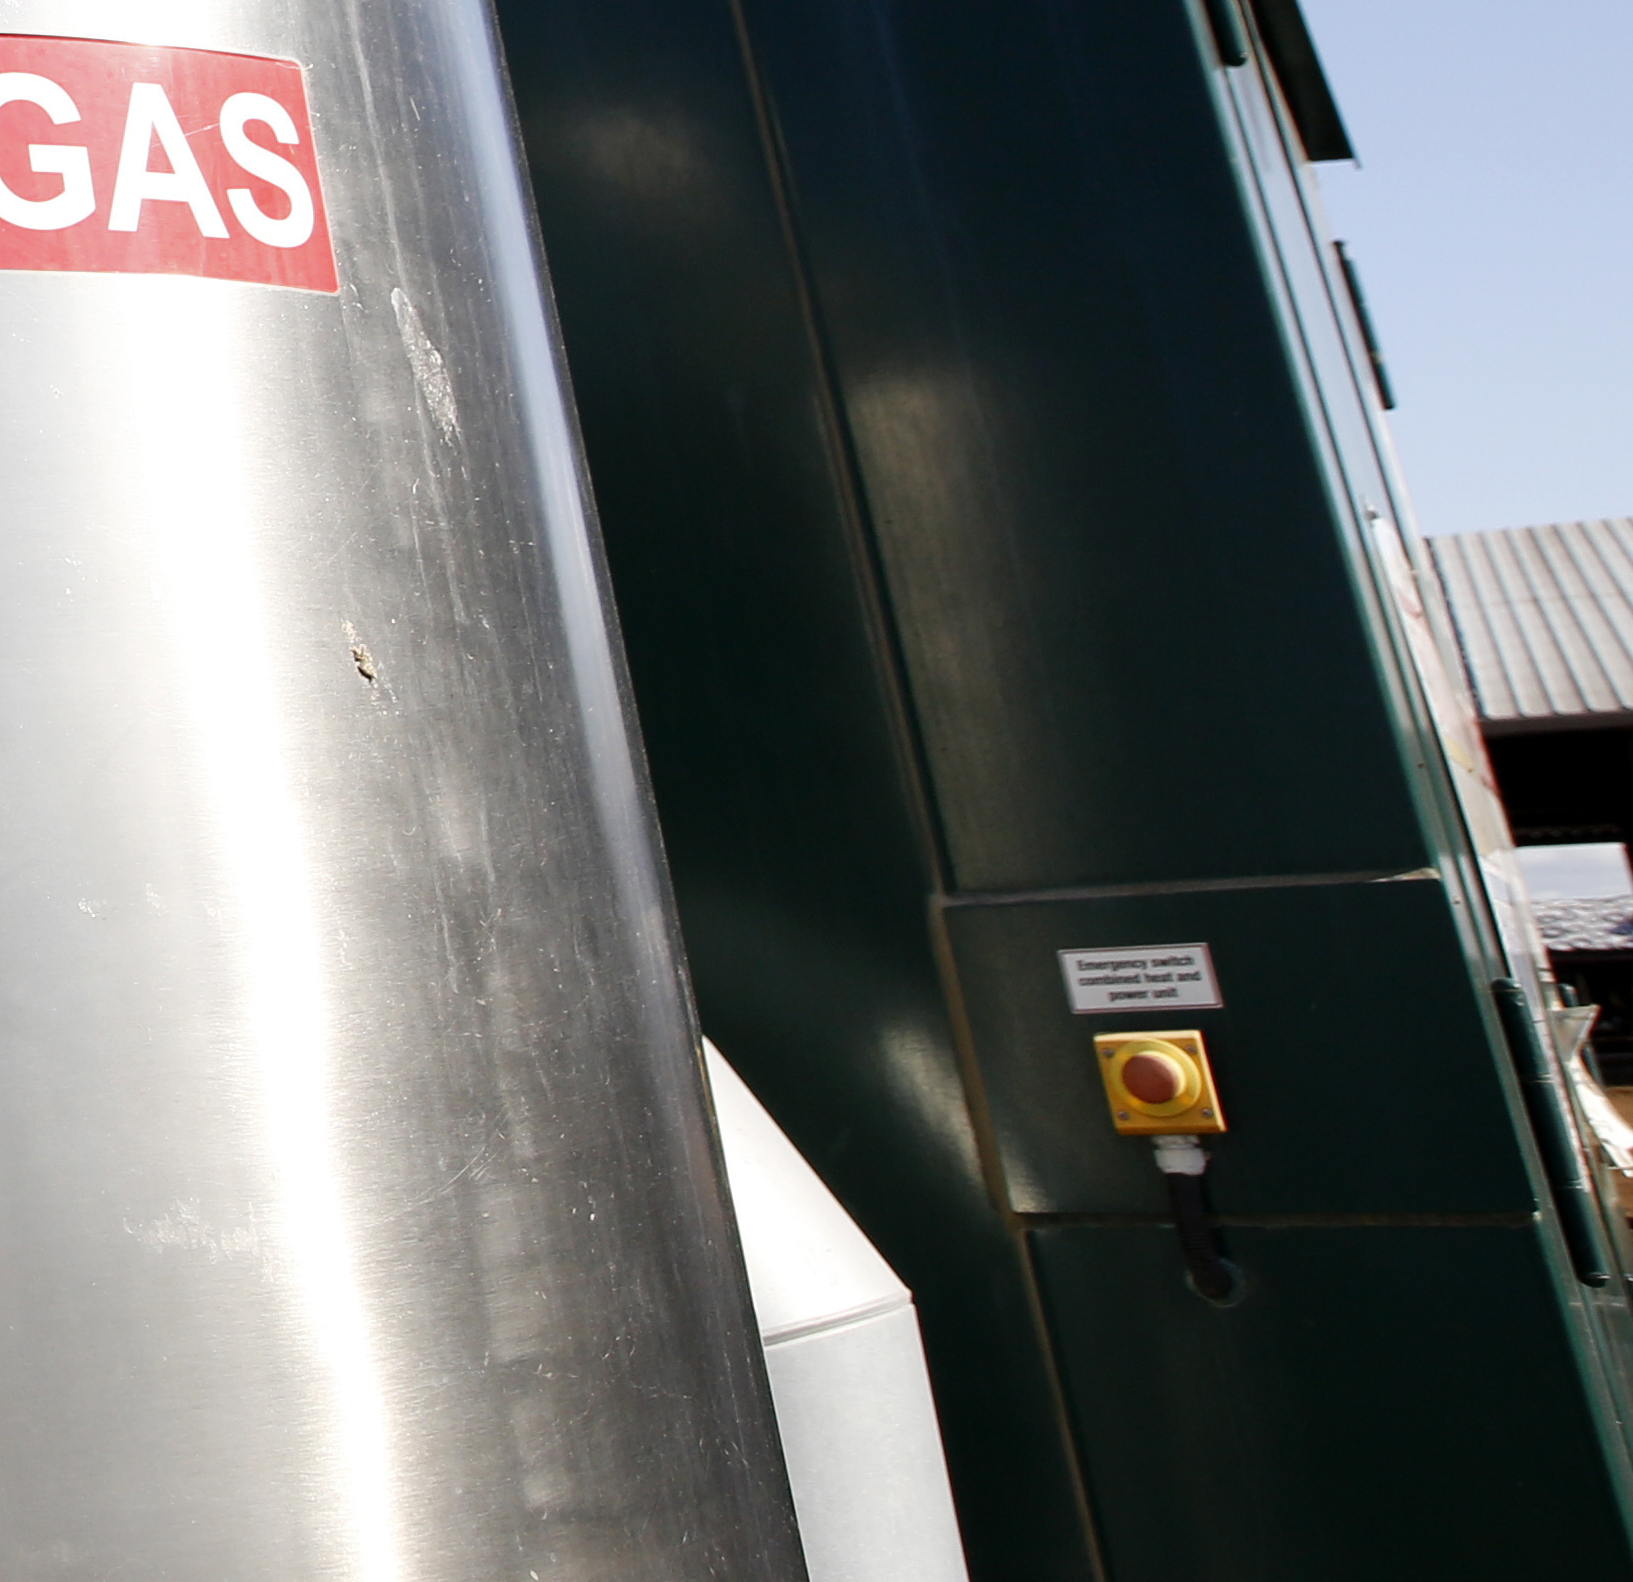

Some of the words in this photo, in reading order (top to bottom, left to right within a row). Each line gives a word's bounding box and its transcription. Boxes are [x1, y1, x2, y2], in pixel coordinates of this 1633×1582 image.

[1076, 958, 1148, 972] Emergency
[1151, 955, 1196, 967] switch
[1077, 973, 1141, 986] combined
[1144, 971, 1173, 983] heat
[1177, 970, 1202, 981] and
[1108, 990, 1149, 1002] power
[1153, 987, 1179, 998] unit
